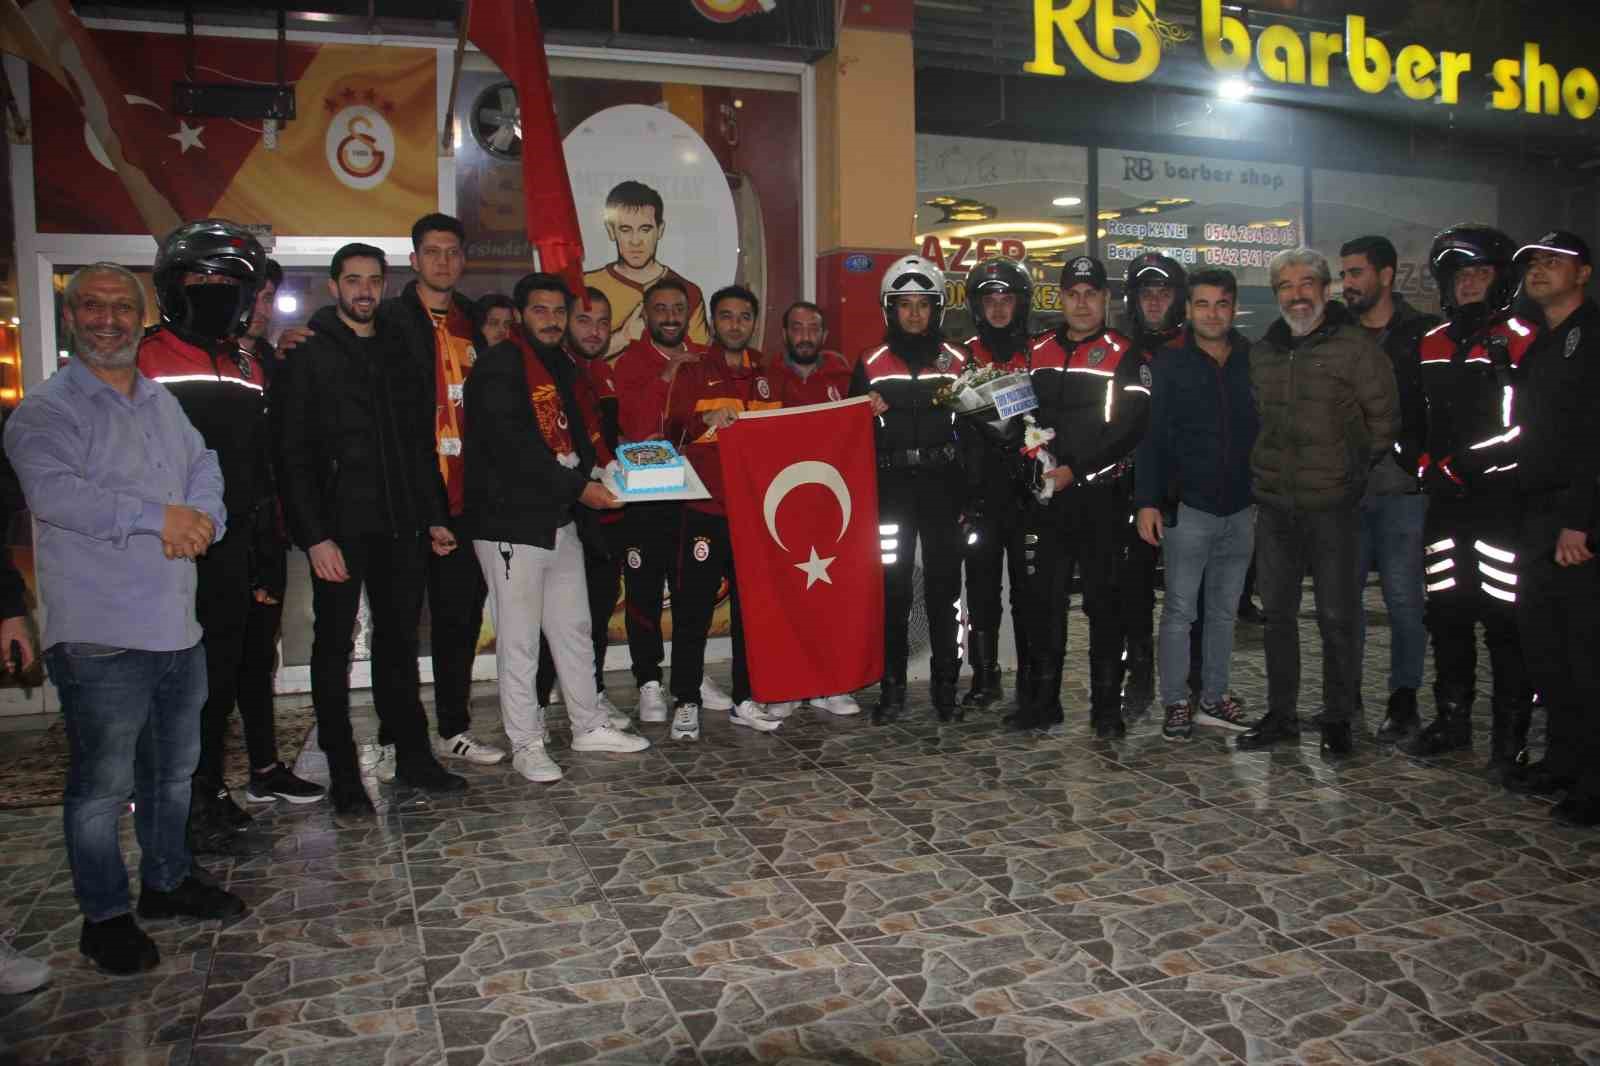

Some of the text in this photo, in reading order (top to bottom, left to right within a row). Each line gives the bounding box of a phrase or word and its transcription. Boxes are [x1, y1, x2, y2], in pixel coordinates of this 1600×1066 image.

[1023, 0, 1161, 83] RB
[1201, 0, 1471, 104] barber
[1122, 156, 1284, 191] RB barber shop
